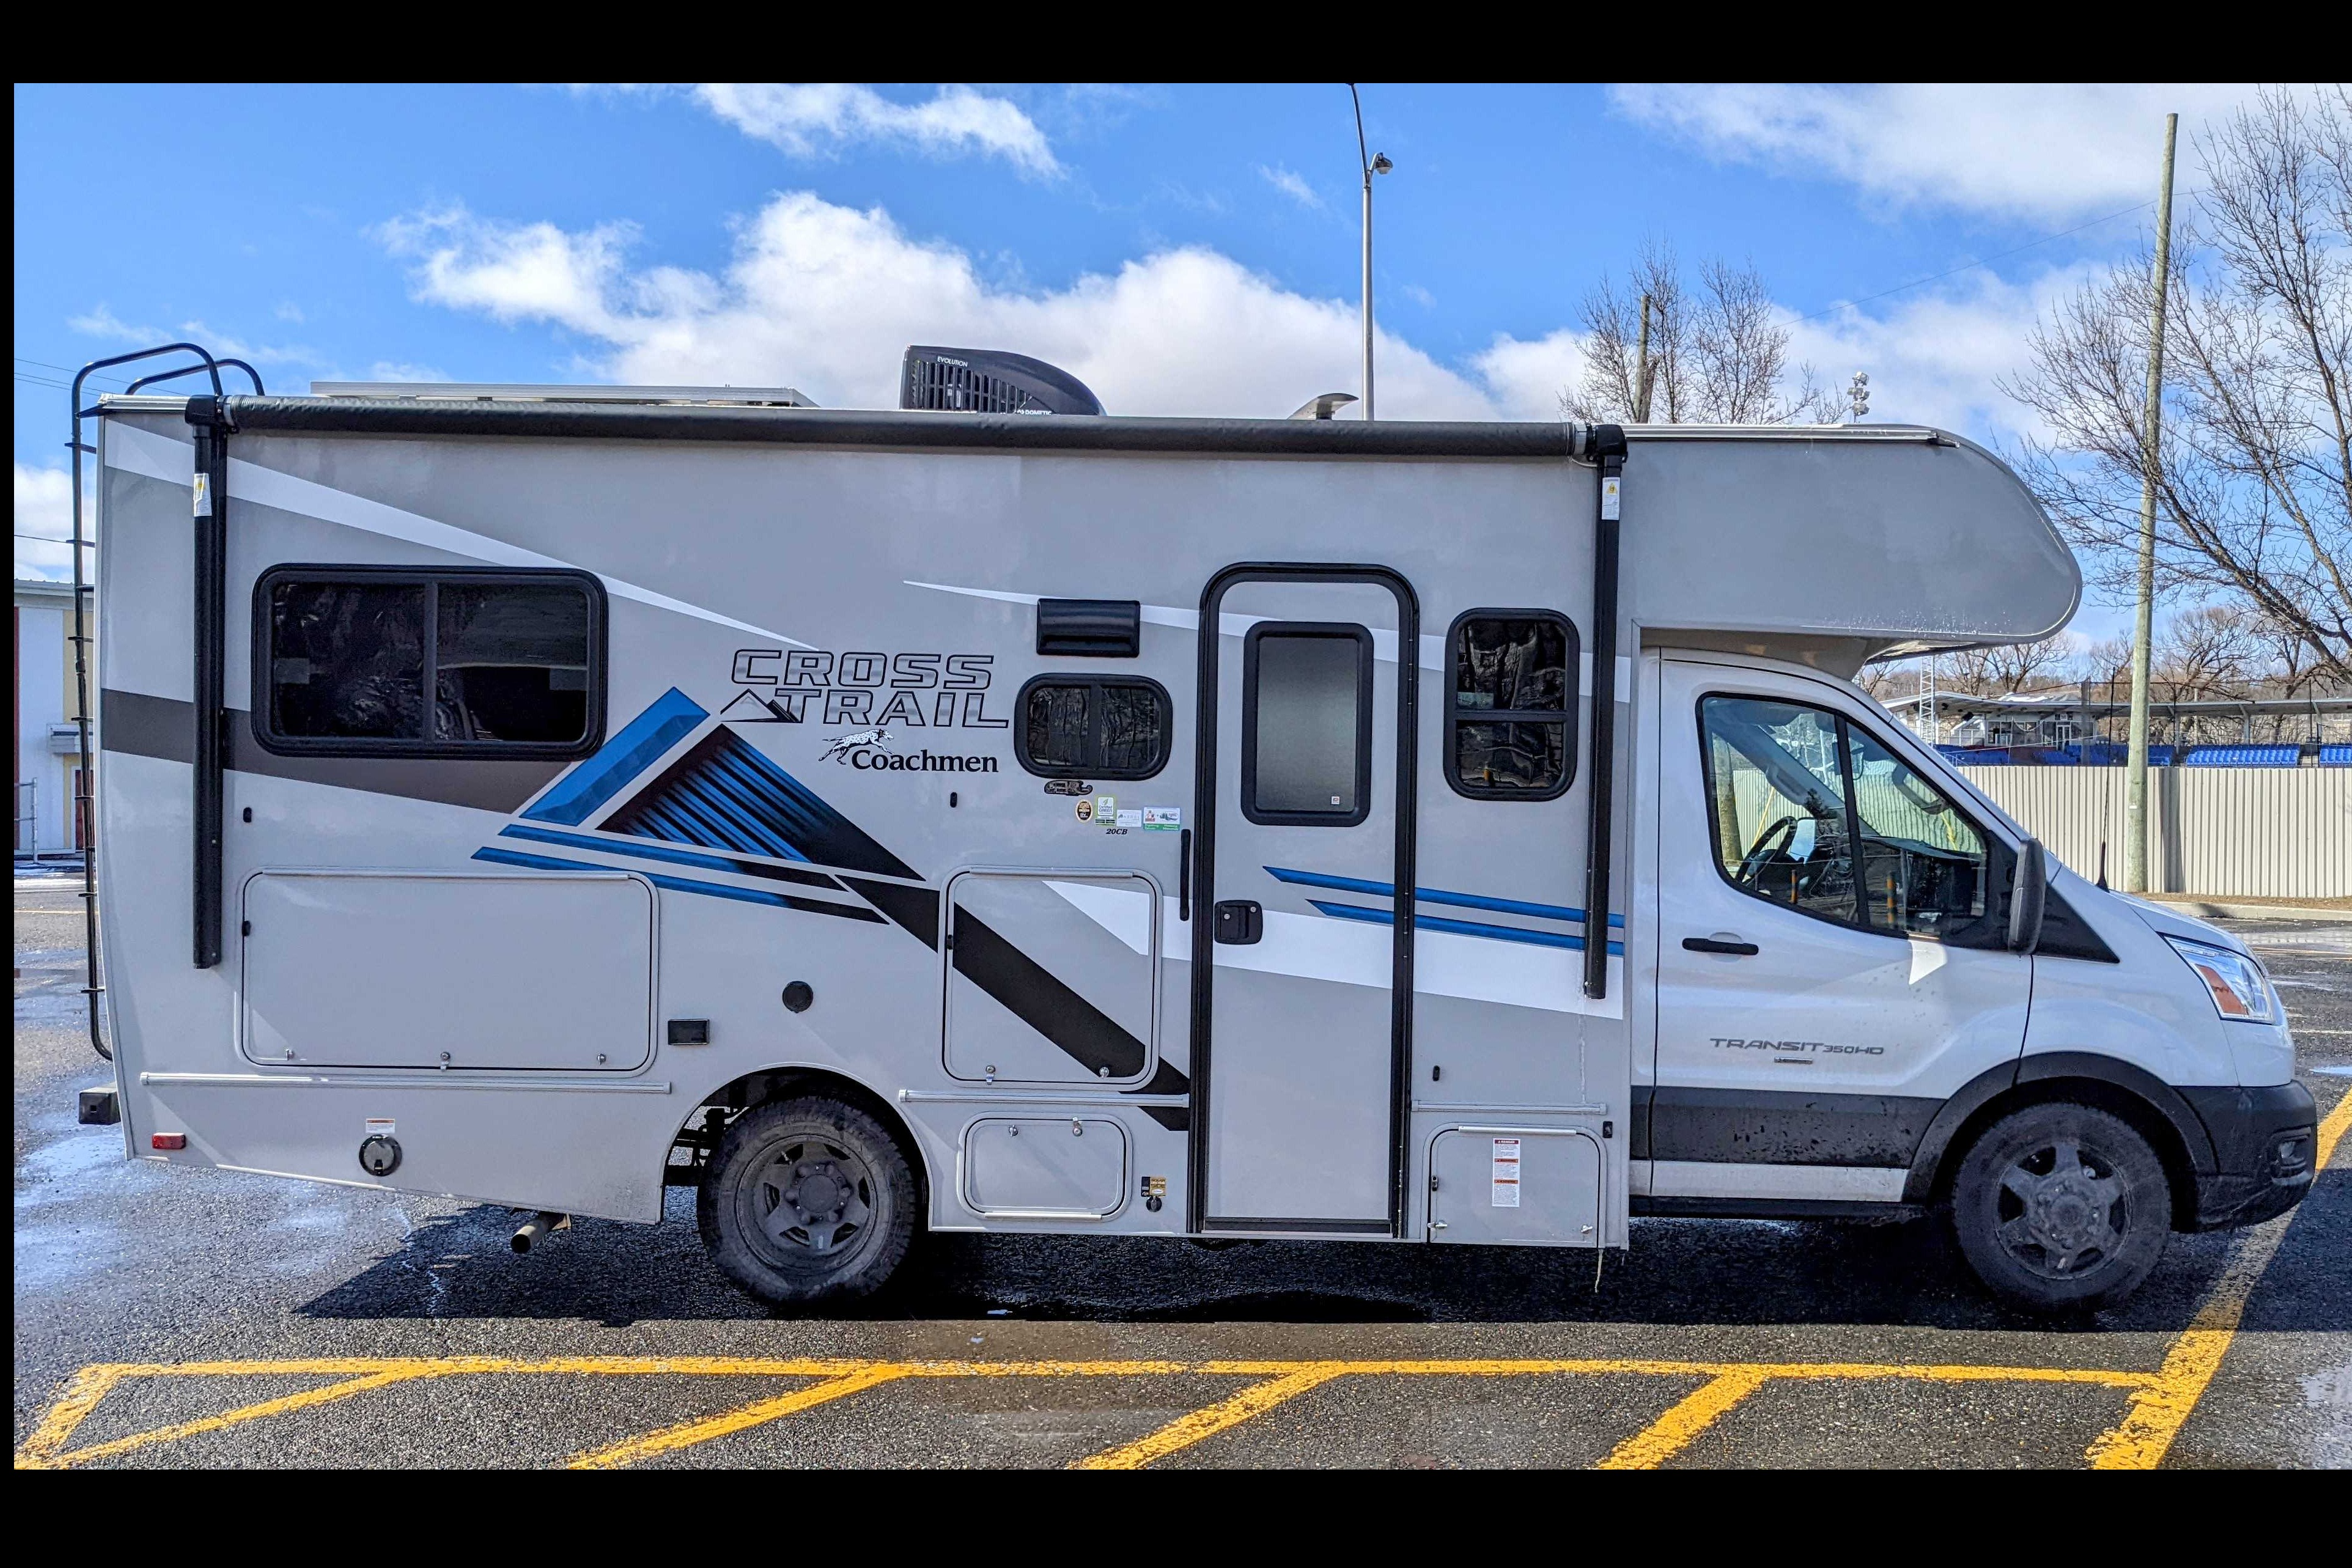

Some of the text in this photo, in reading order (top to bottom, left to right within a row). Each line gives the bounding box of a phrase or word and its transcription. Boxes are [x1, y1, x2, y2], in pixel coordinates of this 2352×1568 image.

[937, 356, 968, 367] EVOLUTION
[731, 649, 994, 689] CROSS
[775, 688, 1009, 728] TRAIL
[851, 749, 999, 773] Coachmen
[1709, 1038, 1825, 1052] TRANSIT
